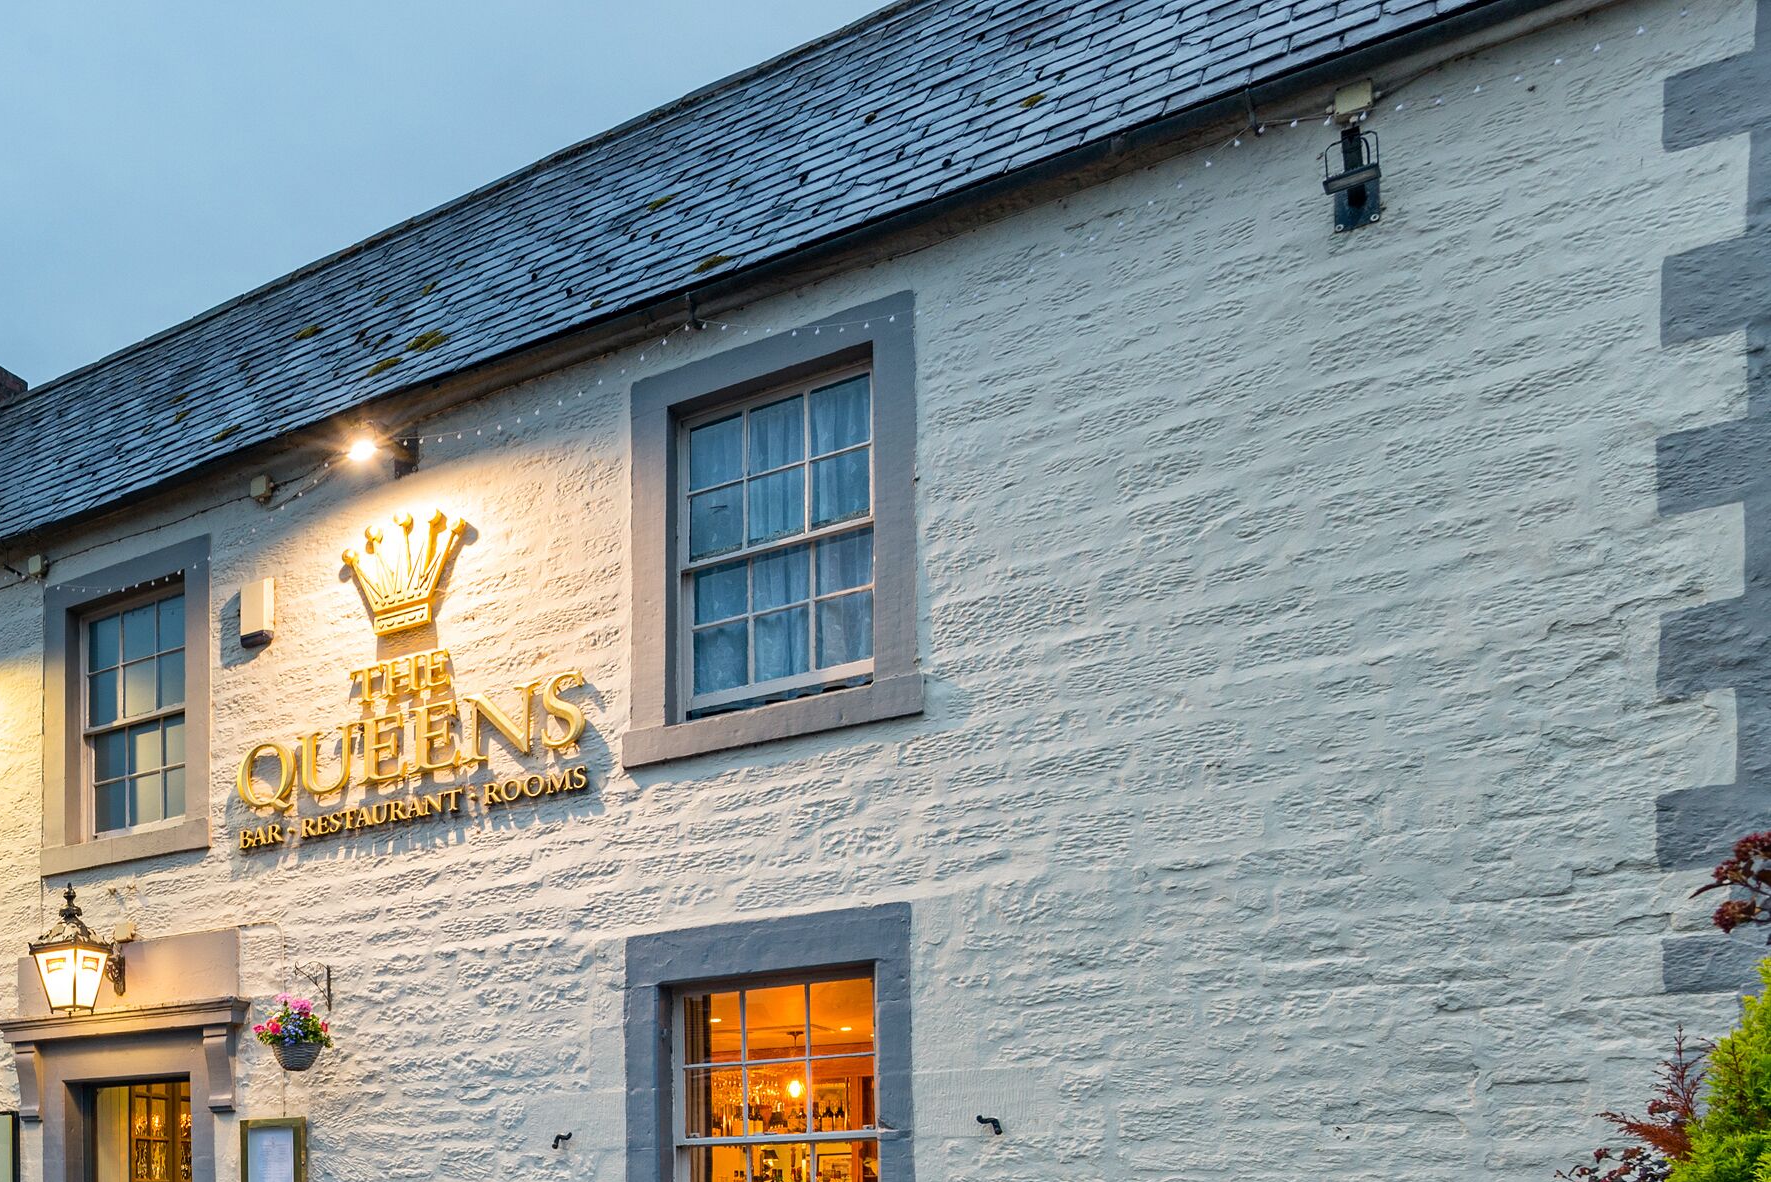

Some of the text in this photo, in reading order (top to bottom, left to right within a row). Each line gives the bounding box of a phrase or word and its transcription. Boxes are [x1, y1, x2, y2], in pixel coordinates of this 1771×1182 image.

[350, 647, 450, 705] THE
[236, 670, 586, 812] QUEENS
[238, 765, 588, 850] BAR RESTAURANT ROOMS
